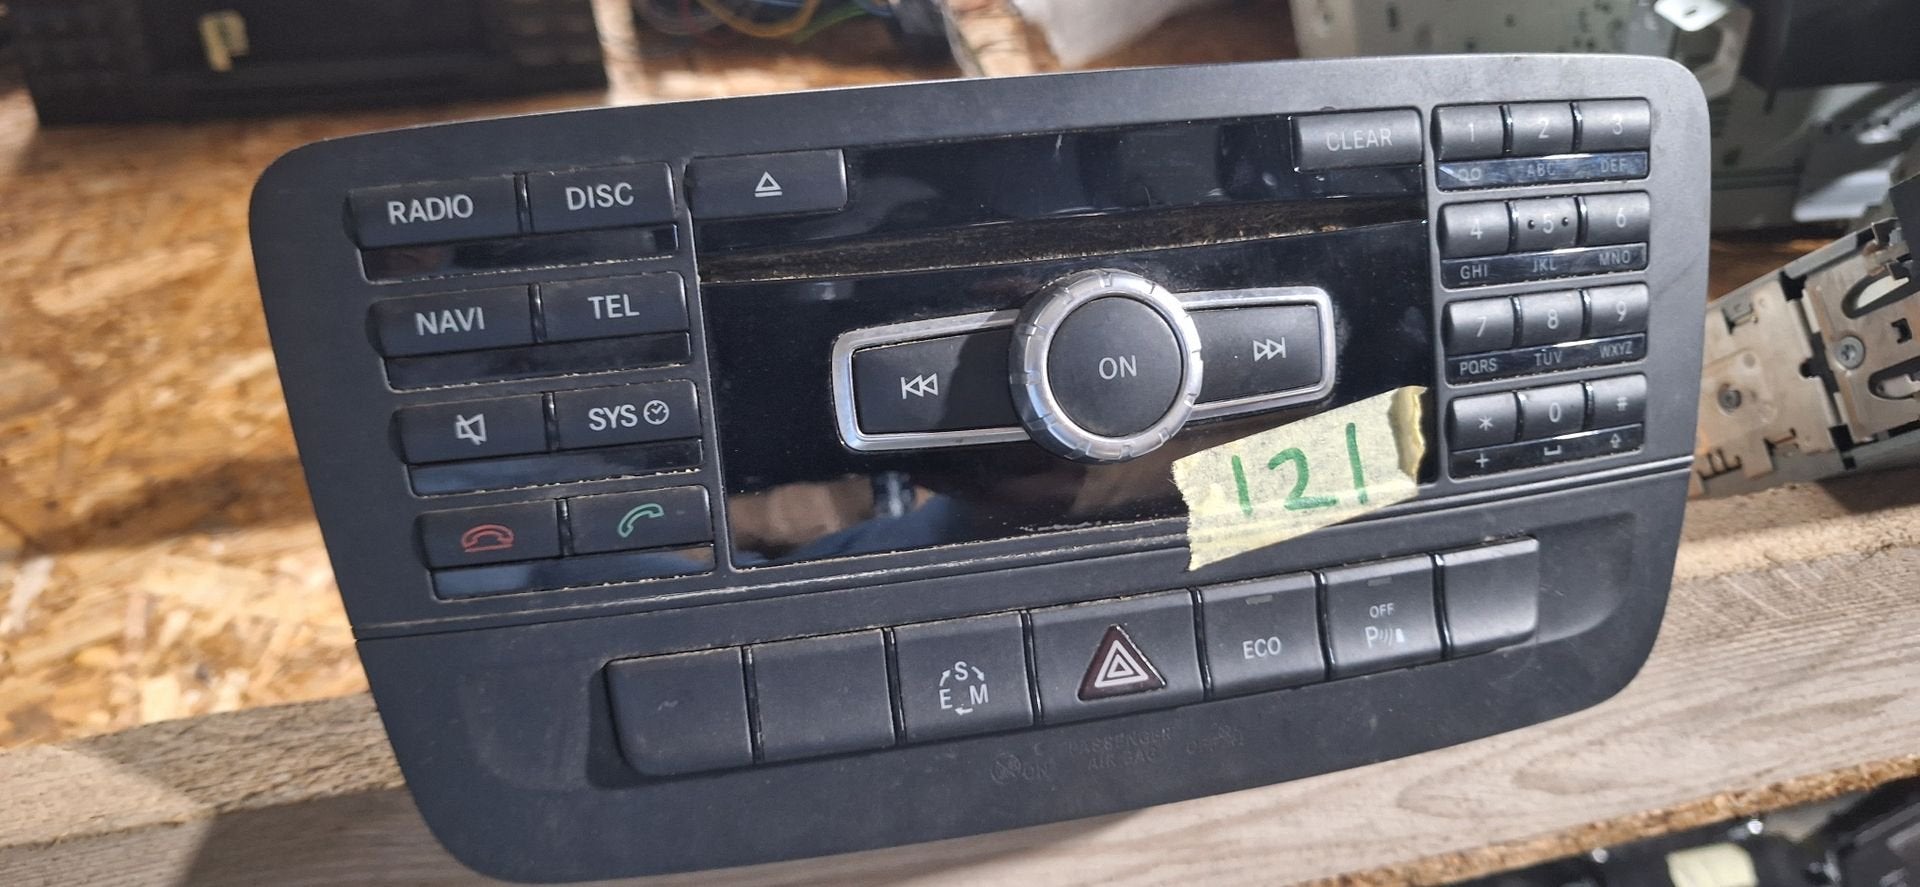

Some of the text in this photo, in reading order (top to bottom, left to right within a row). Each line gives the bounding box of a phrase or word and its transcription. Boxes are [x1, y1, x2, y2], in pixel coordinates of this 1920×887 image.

[1468, 122, 1475, 142] 1
[1538, 117, 1550, 139] 2
[1612, 114, 1624, 135] 3
[1326, 128, 1393, 152] CLEAR
[1526, 163, 1556, 178] ABC
[1601, 158, 1627, 173] DEF
[565, 182, 635, 211] DISC
[387, 194, 474, 225] RADIO
[1615, 206, 1627, 229] 6
[1470, 218, 1483, 241] 4
[1542, 213, 1554, 234] 5
[1532, 257, 1557, 274] JKL
[1600, 250, 1631, 266] MNO
[1460, 264, 1488, 280] GHI
[587, 294, 641, 320] TEL
[1615, 301, 1627, 323] 9
[414, 306, 486, 336] NAVI
[1475, 316, 1487, 338] 7
[1547, 308, 1560, 330] 8
[1534, 351, 1563, 367] TUV
[1600, 341, 1633, 359] WXYZ
[1098, 354, 1138, 381] ON
[1459, 358, 1498, 375] PQRS
[588, 404, 639, 432] SYS
[1549, 402, 1561, 423] 0
[1231, 421, 1370, 519] 121
[1369, 602, 1395, 619] OFF
[1242, 636, 1282, 660] ECO
[954, 661, 969, 681] S
[939, 683, 989, 710] E M
